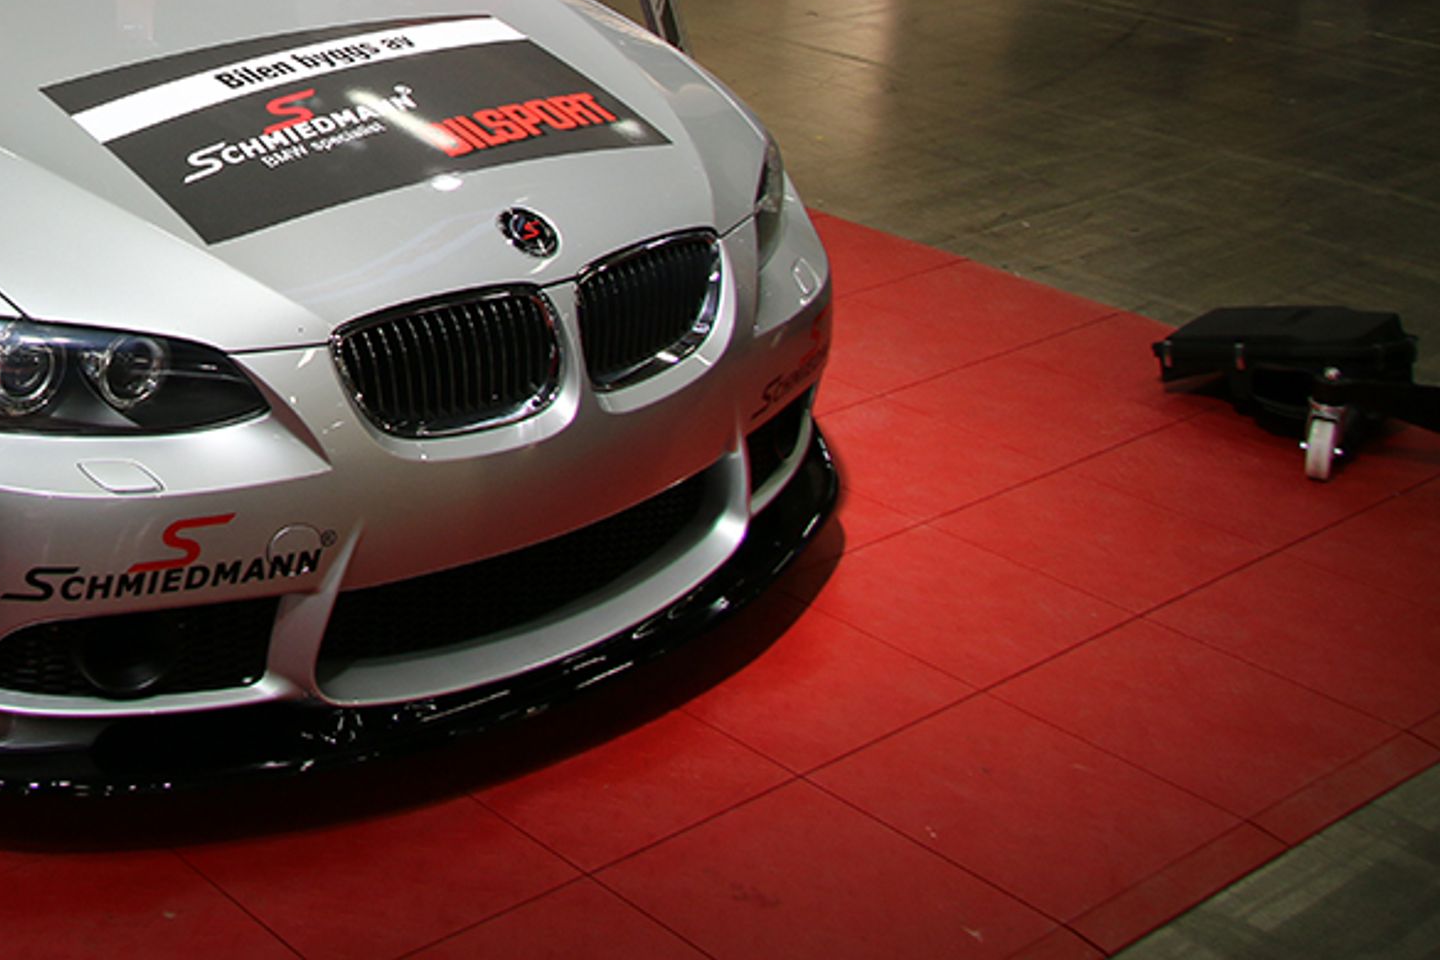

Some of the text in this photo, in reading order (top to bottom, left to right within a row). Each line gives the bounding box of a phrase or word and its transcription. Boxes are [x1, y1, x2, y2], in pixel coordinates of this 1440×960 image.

[214, 33, 416, 90] Bilen byggs av
[260, 121, 387, 169] BMW specialist
[0, 548, 322, 602] SCHMIEDMANN
